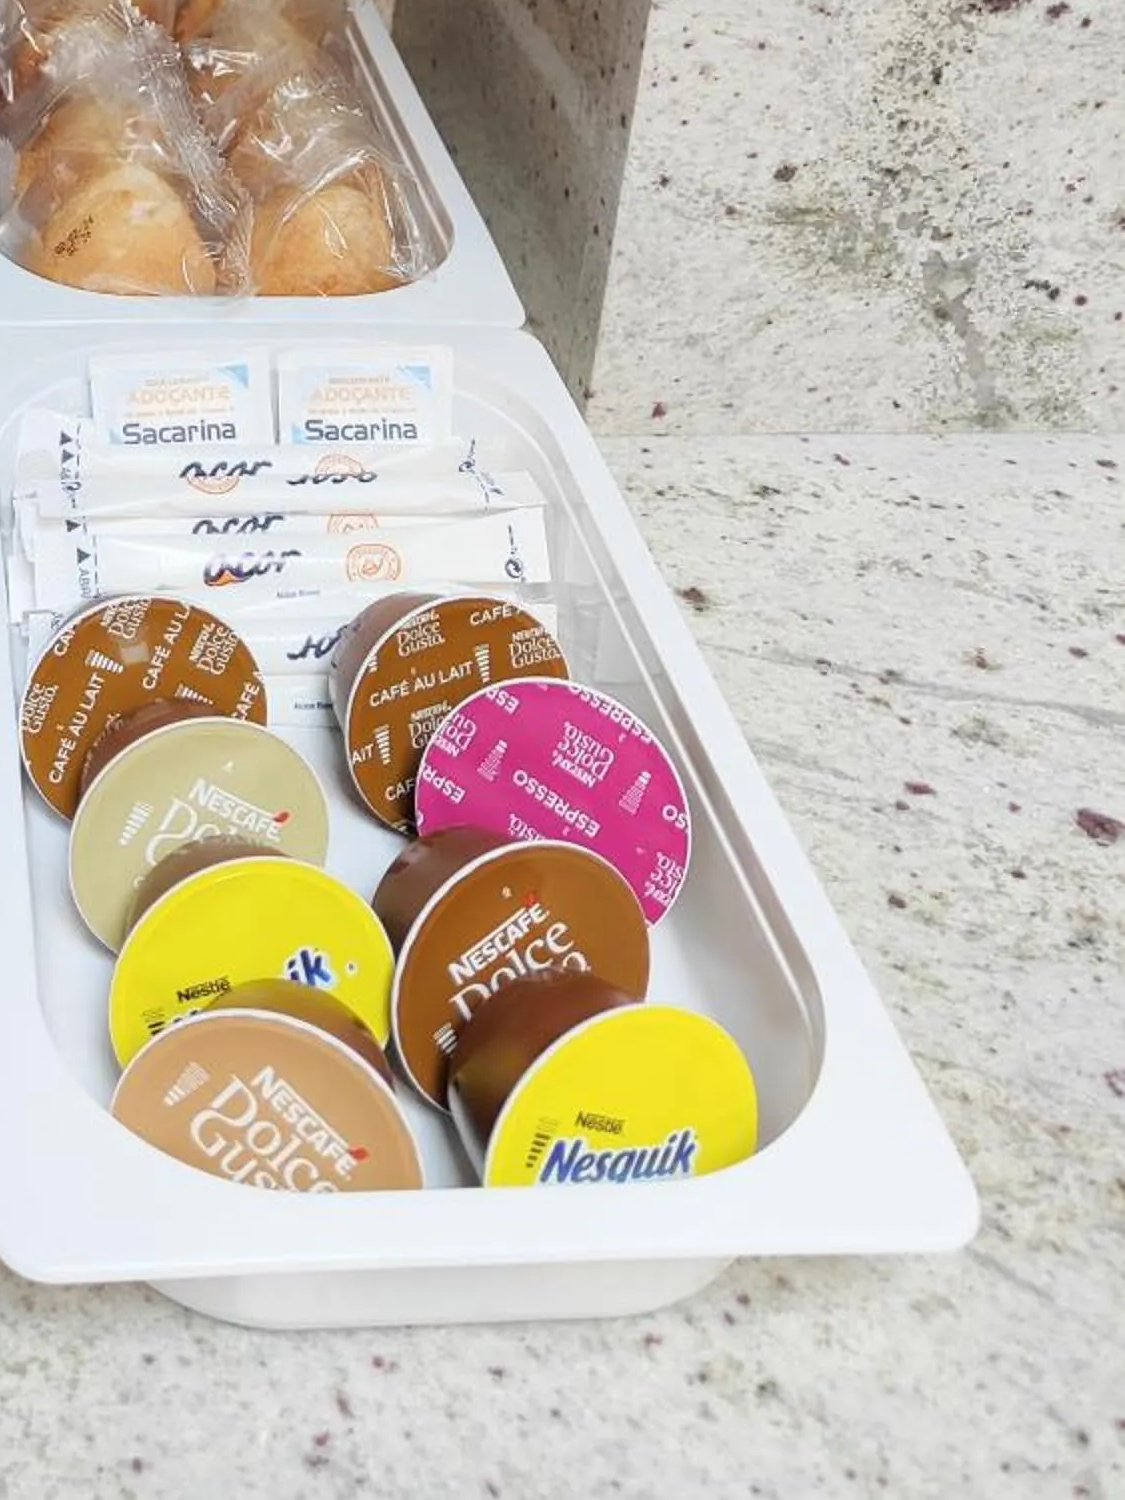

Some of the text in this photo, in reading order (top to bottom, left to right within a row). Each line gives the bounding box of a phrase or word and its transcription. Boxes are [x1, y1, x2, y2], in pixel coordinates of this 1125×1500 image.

[123, 419, 236, 445] Sacarina
[305, 417, 418, 441] Sacarina
[470, 604, 508, 626] CAFÉ
[142, 645, 171, 690] CAFÉ
[163, 623, 183, 646] AU
[370, 661, 474, 708] CAFÉ AU LAIT
[48, 672, 106, 784] CAFÉ AU LAIT
[385, 780, 414, 802] CAF
[512, 769, 601, 838] ESPRESSO
[539, 1130, 698, 1184] Nesquik
